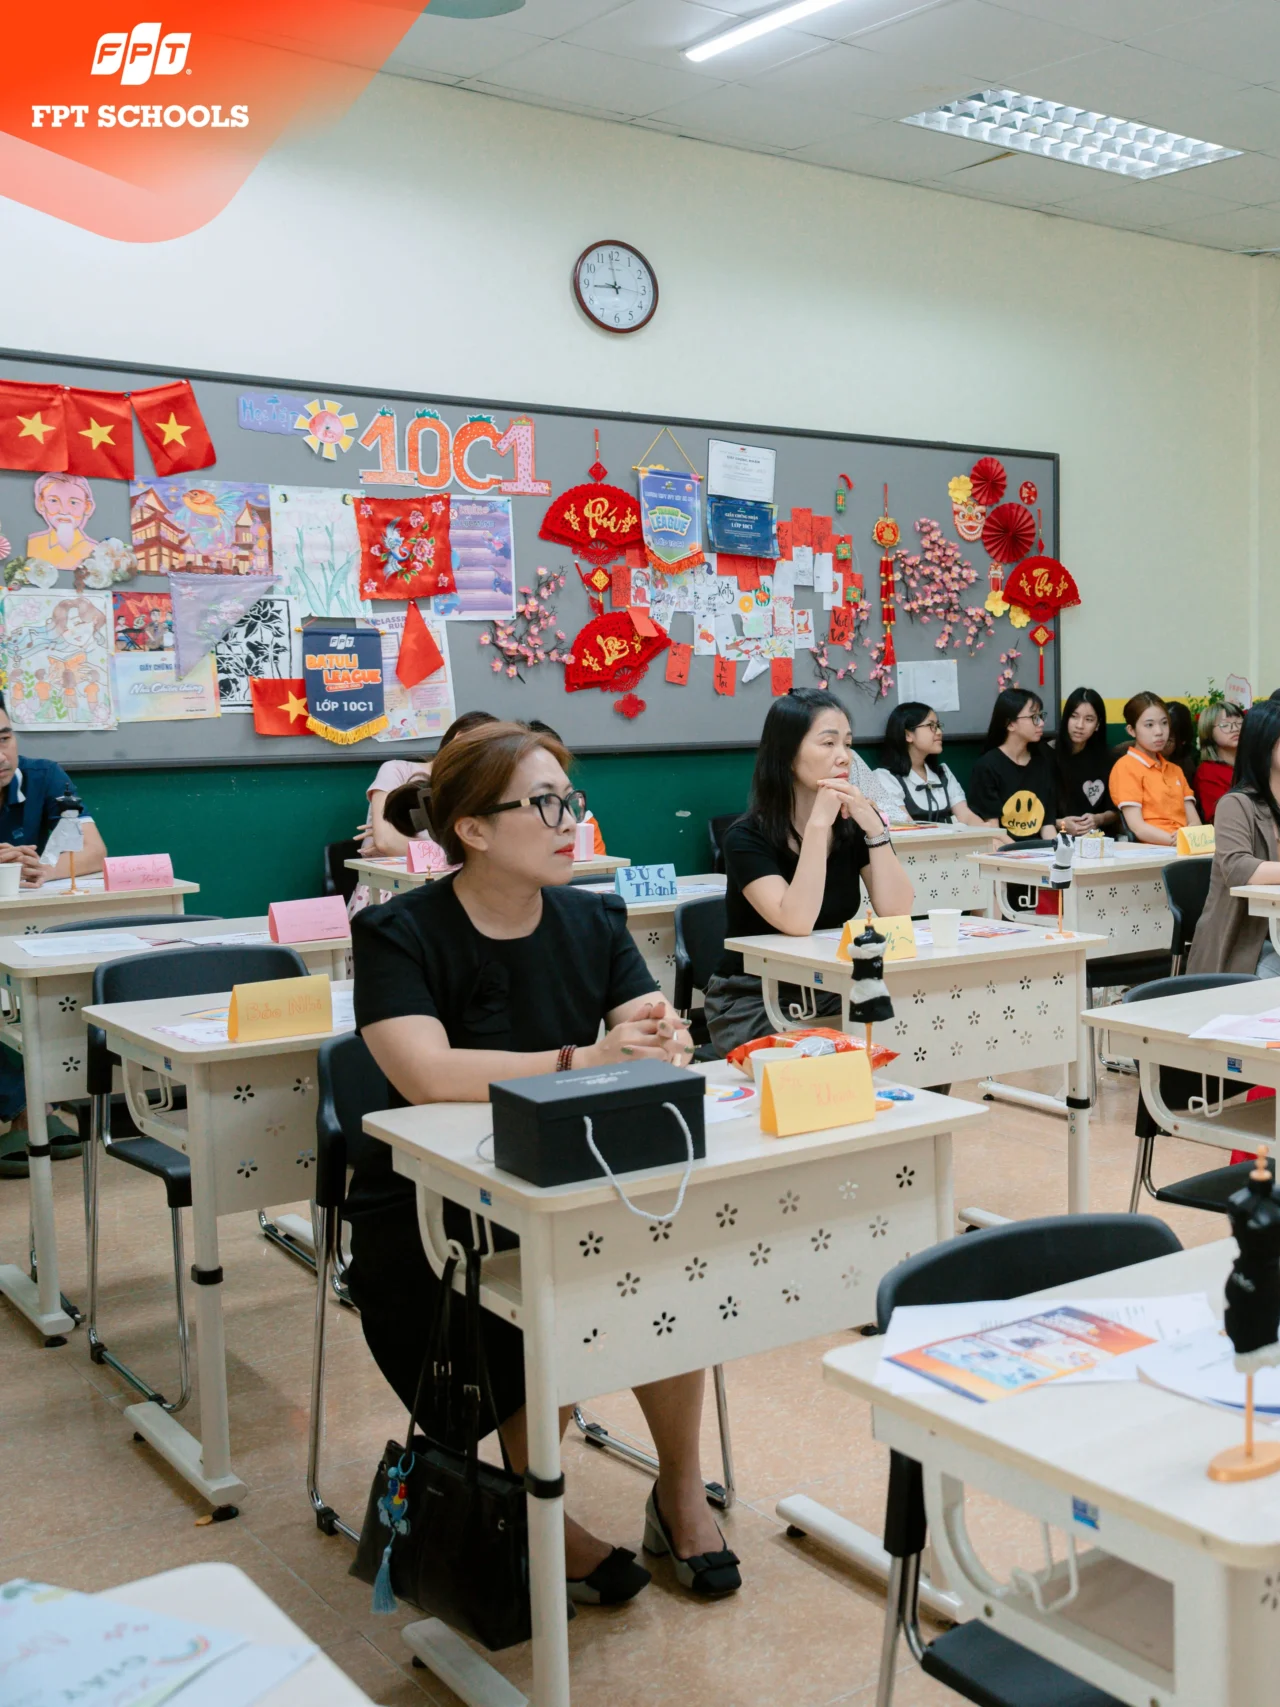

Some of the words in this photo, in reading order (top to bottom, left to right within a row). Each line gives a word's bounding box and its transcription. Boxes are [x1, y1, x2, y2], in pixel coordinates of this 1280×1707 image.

[597, 253, 604, 264] 11
[586, 263, 596, 274] 10
[637, 269, 643, 280] 2
[583, 278, 590, 288] 9
[640, 285, 647, 296] 3
[588, 295, 594, 305] 8
[637, 301, 643, 310] 4
[599, 308, 605, 318] 7
[614, 313, 620, 323] 6
[628, 311, 634, 321] 5
[360, 406, 552, 497] 10C1
[650, 514, 689, 534] LEAGUE
[305, 653, 359, 670] BATULI
[323, 669, 382, 685] LEAGUE
[316, 699, 339, 712] LỚP
[342, 701, 373, 712] 10C1
[1007, 818, 1037, 830] drew
[630, 881, 677, 897] Thành
